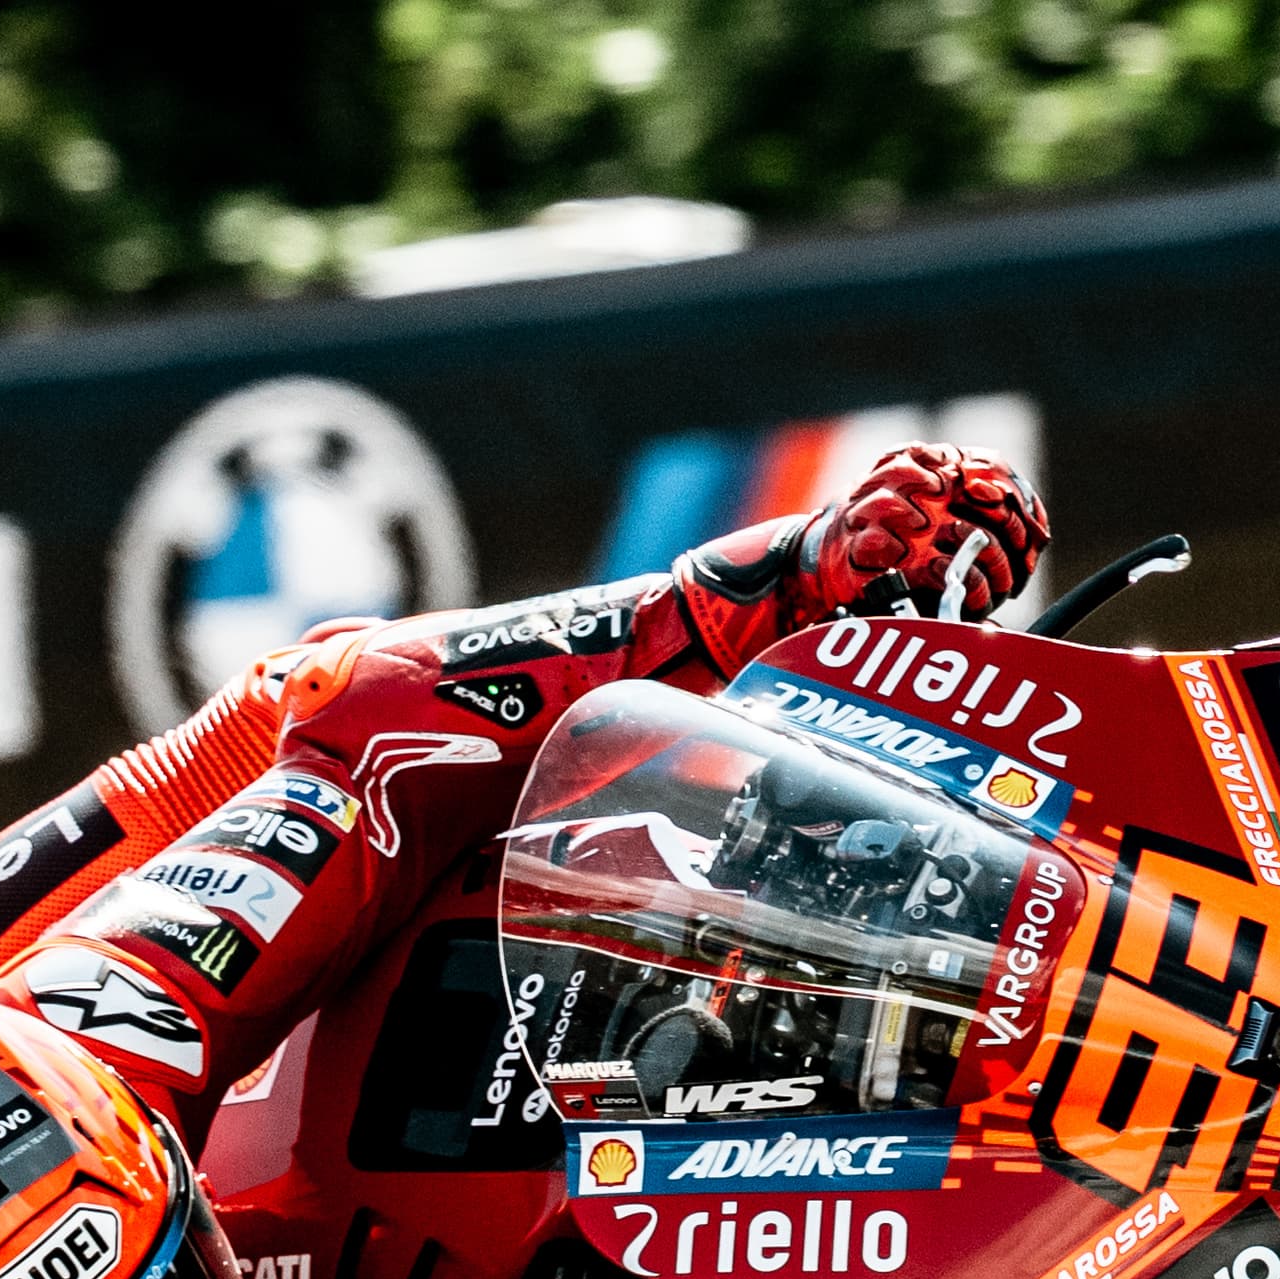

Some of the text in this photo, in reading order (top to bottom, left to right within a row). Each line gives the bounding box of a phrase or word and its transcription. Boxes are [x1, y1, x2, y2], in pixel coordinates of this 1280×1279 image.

[458, 607, 623, 655] Leovo
[816, 618, 1037, 728] riello
[762, 681, 970, 768] ADVANCE
[977, 861, 1068, 1048] VARGROUP
[470, 973, 545, 1127] Lenovo
[544, 1060, 636, 1081] MARQUEZ
[664, 1074, 824, 1115] WRS
[667, 1134, 909, 1181] ADVANCE
[674, 1199, 910, 1276] riello
